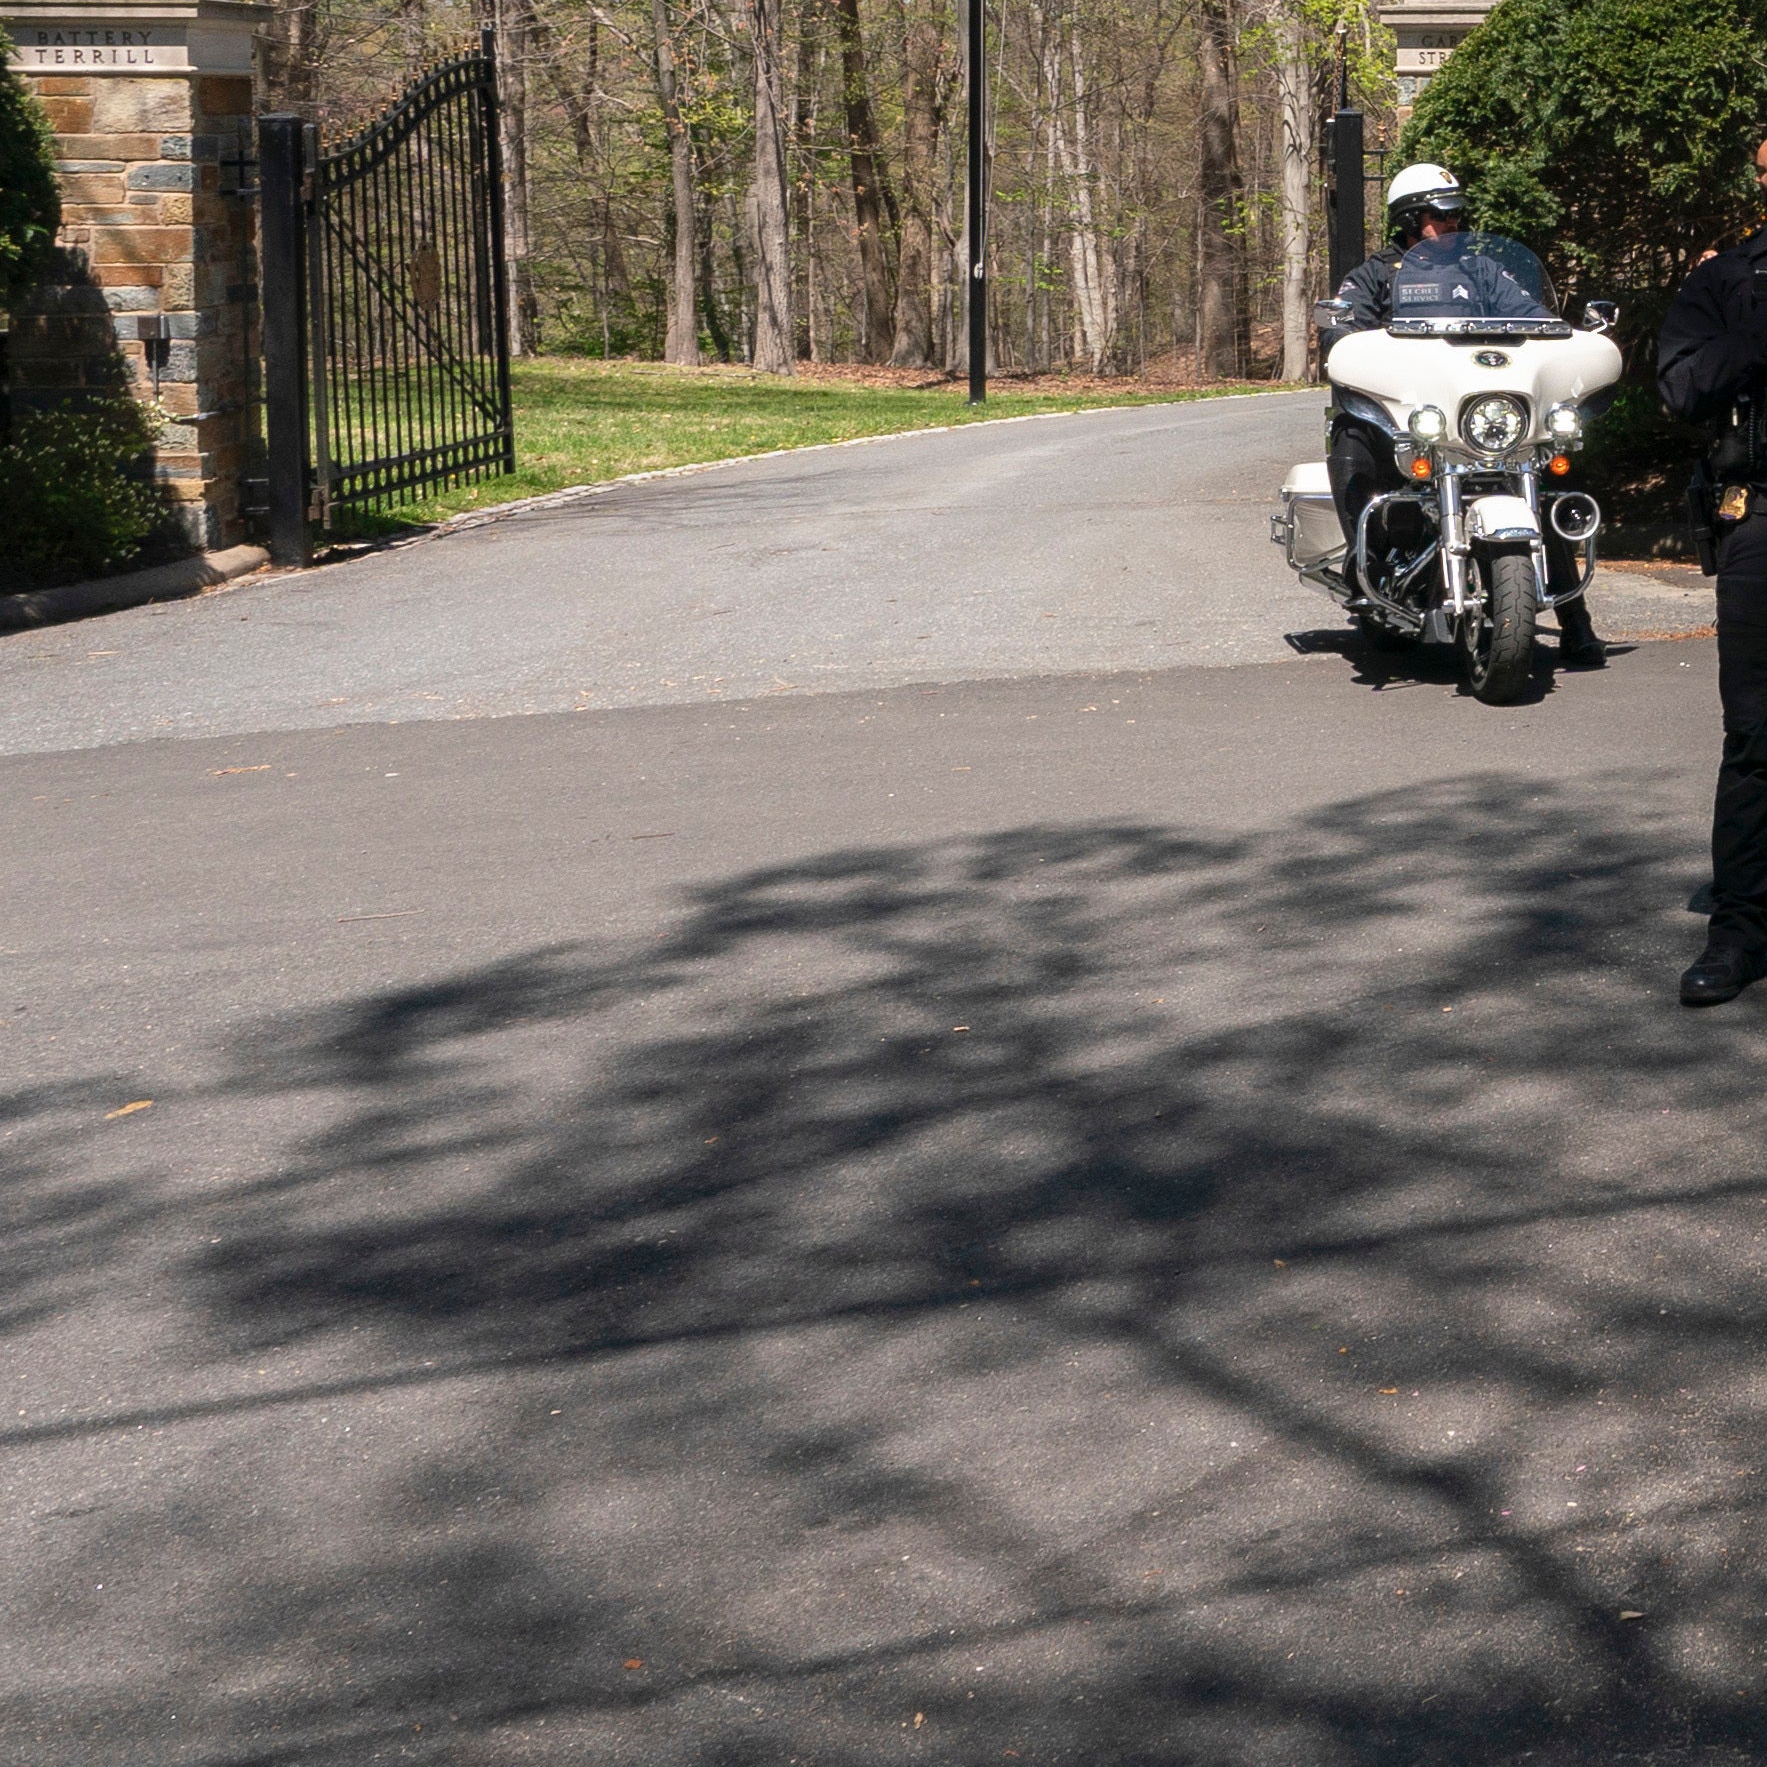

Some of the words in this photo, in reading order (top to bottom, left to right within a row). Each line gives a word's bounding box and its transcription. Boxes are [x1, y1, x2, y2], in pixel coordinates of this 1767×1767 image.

[37, 30, 153, 46] BATTERY
[35, 49, 154, 64] TERRILL
[1401, 295, 1439, 303] SERVICE
